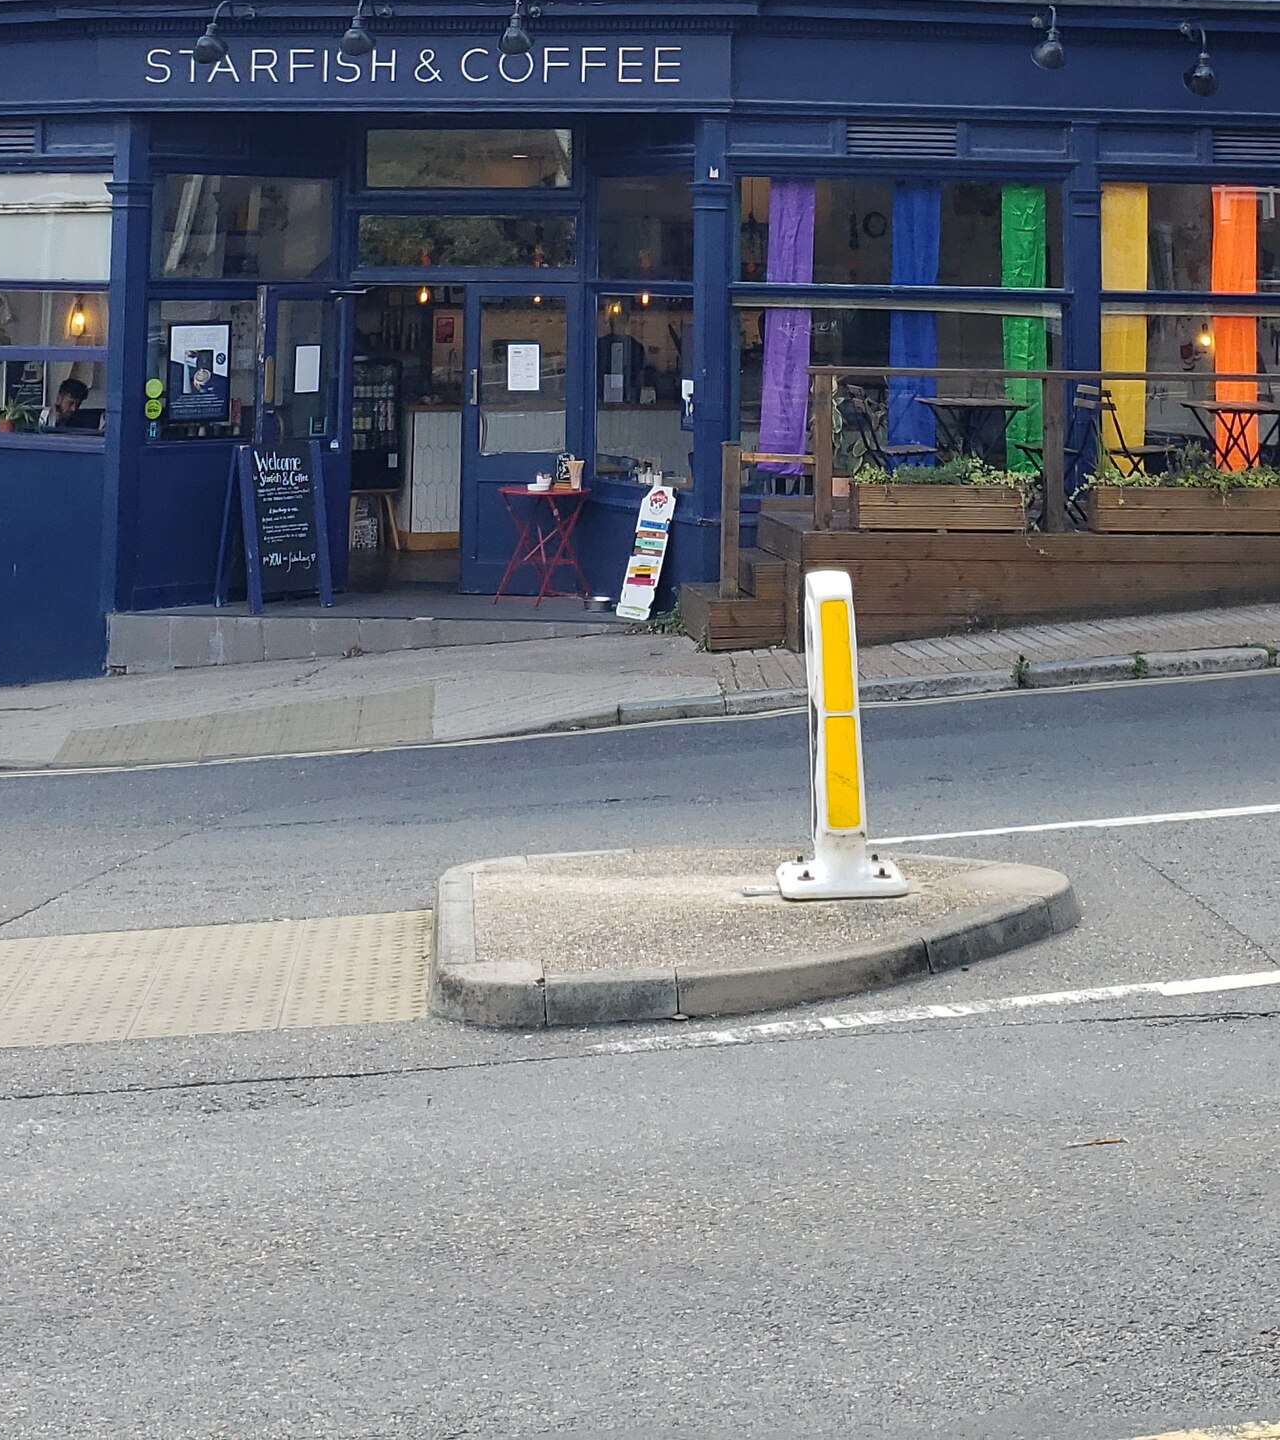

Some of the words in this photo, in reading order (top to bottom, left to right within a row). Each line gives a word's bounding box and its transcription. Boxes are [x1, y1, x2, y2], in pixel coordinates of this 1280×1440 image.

[146, 48, 396, 84] STARFISH
[414, 48, 443, 84] &
[460, 47, 682, 84] COFFEE
[253, 450, 302, 472] Welcome
[282, 471, 290, 486] &
[290, 471, 309, 486] Coffee
